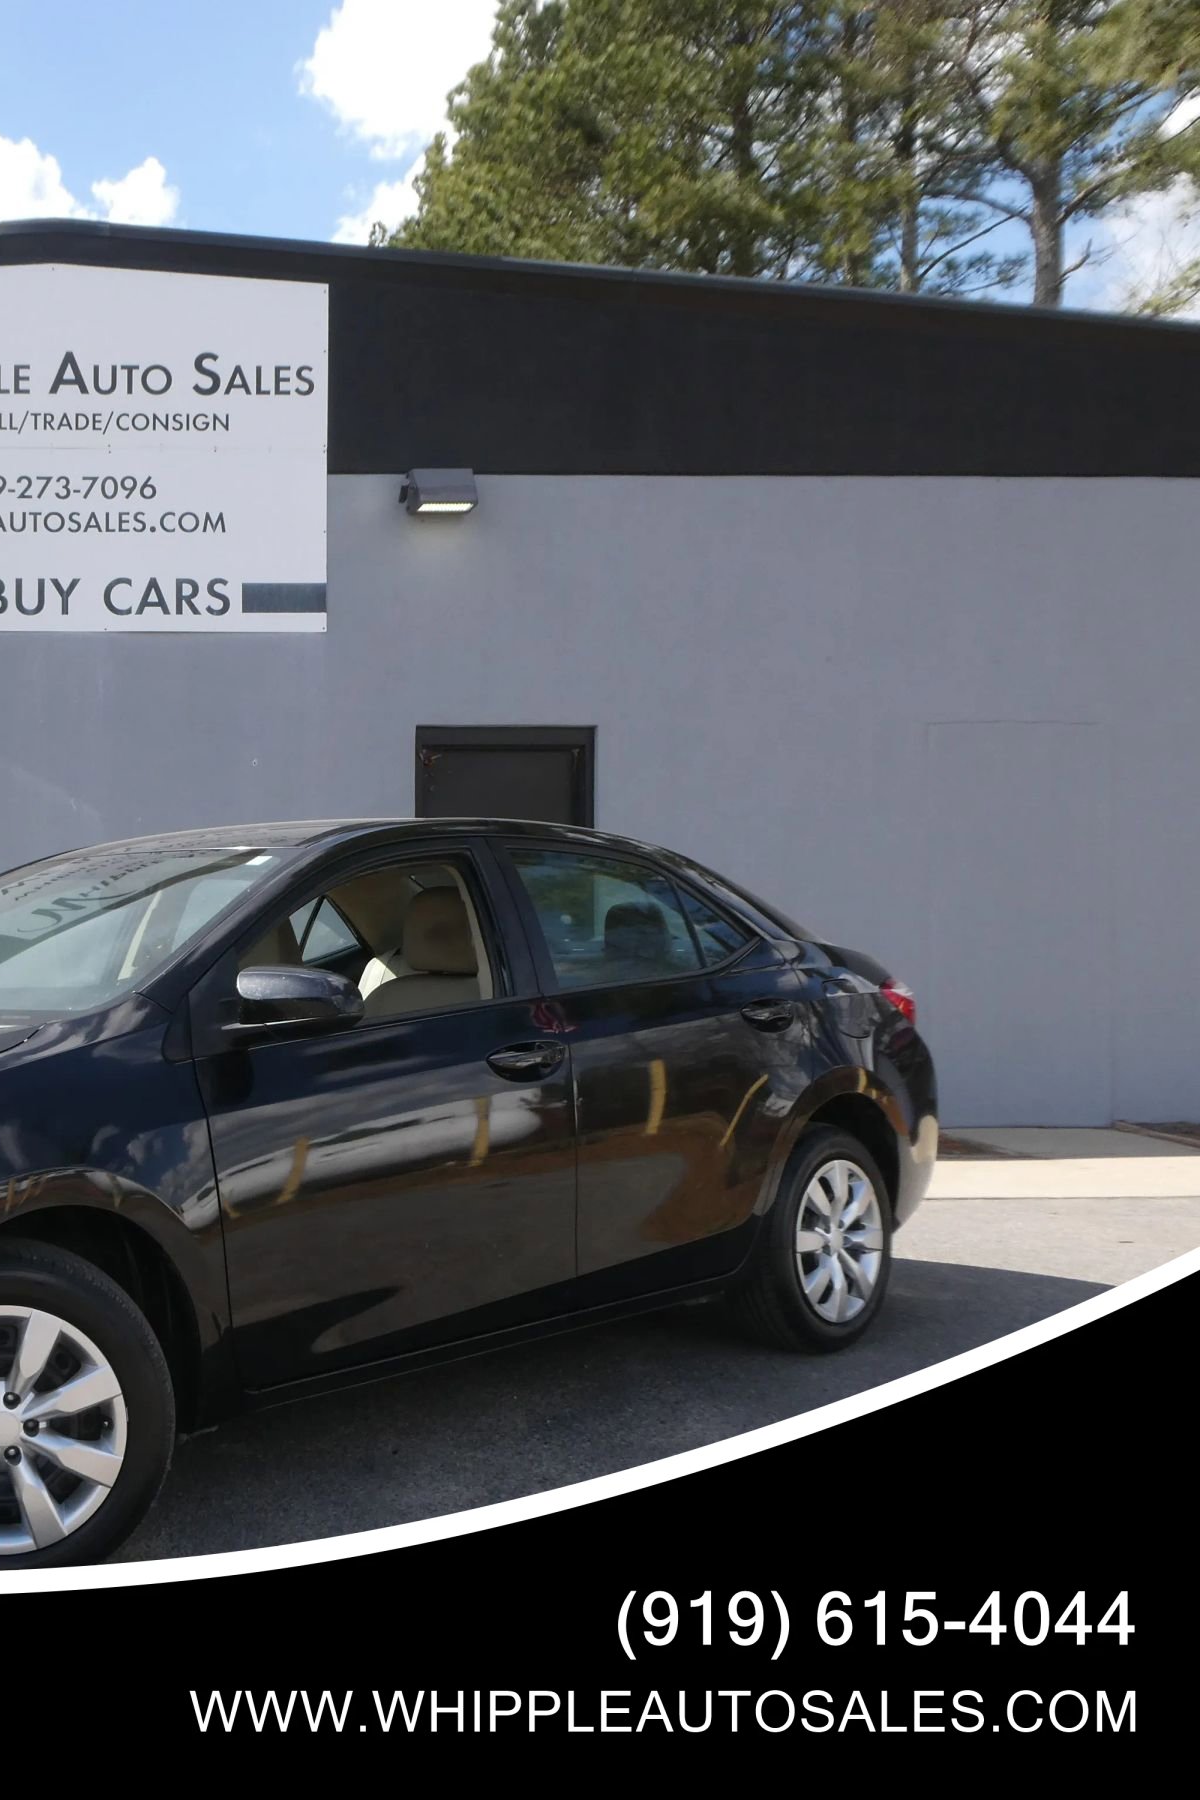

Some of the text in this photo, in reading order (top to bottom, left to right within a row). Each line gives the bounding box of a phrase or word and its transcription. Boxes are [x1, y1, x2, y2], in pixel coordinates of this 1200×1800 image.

[48, 351, 173, 396] AUTO
[192, 352, 315, 397] SALES
[103, 577, 231, 617] CARS
